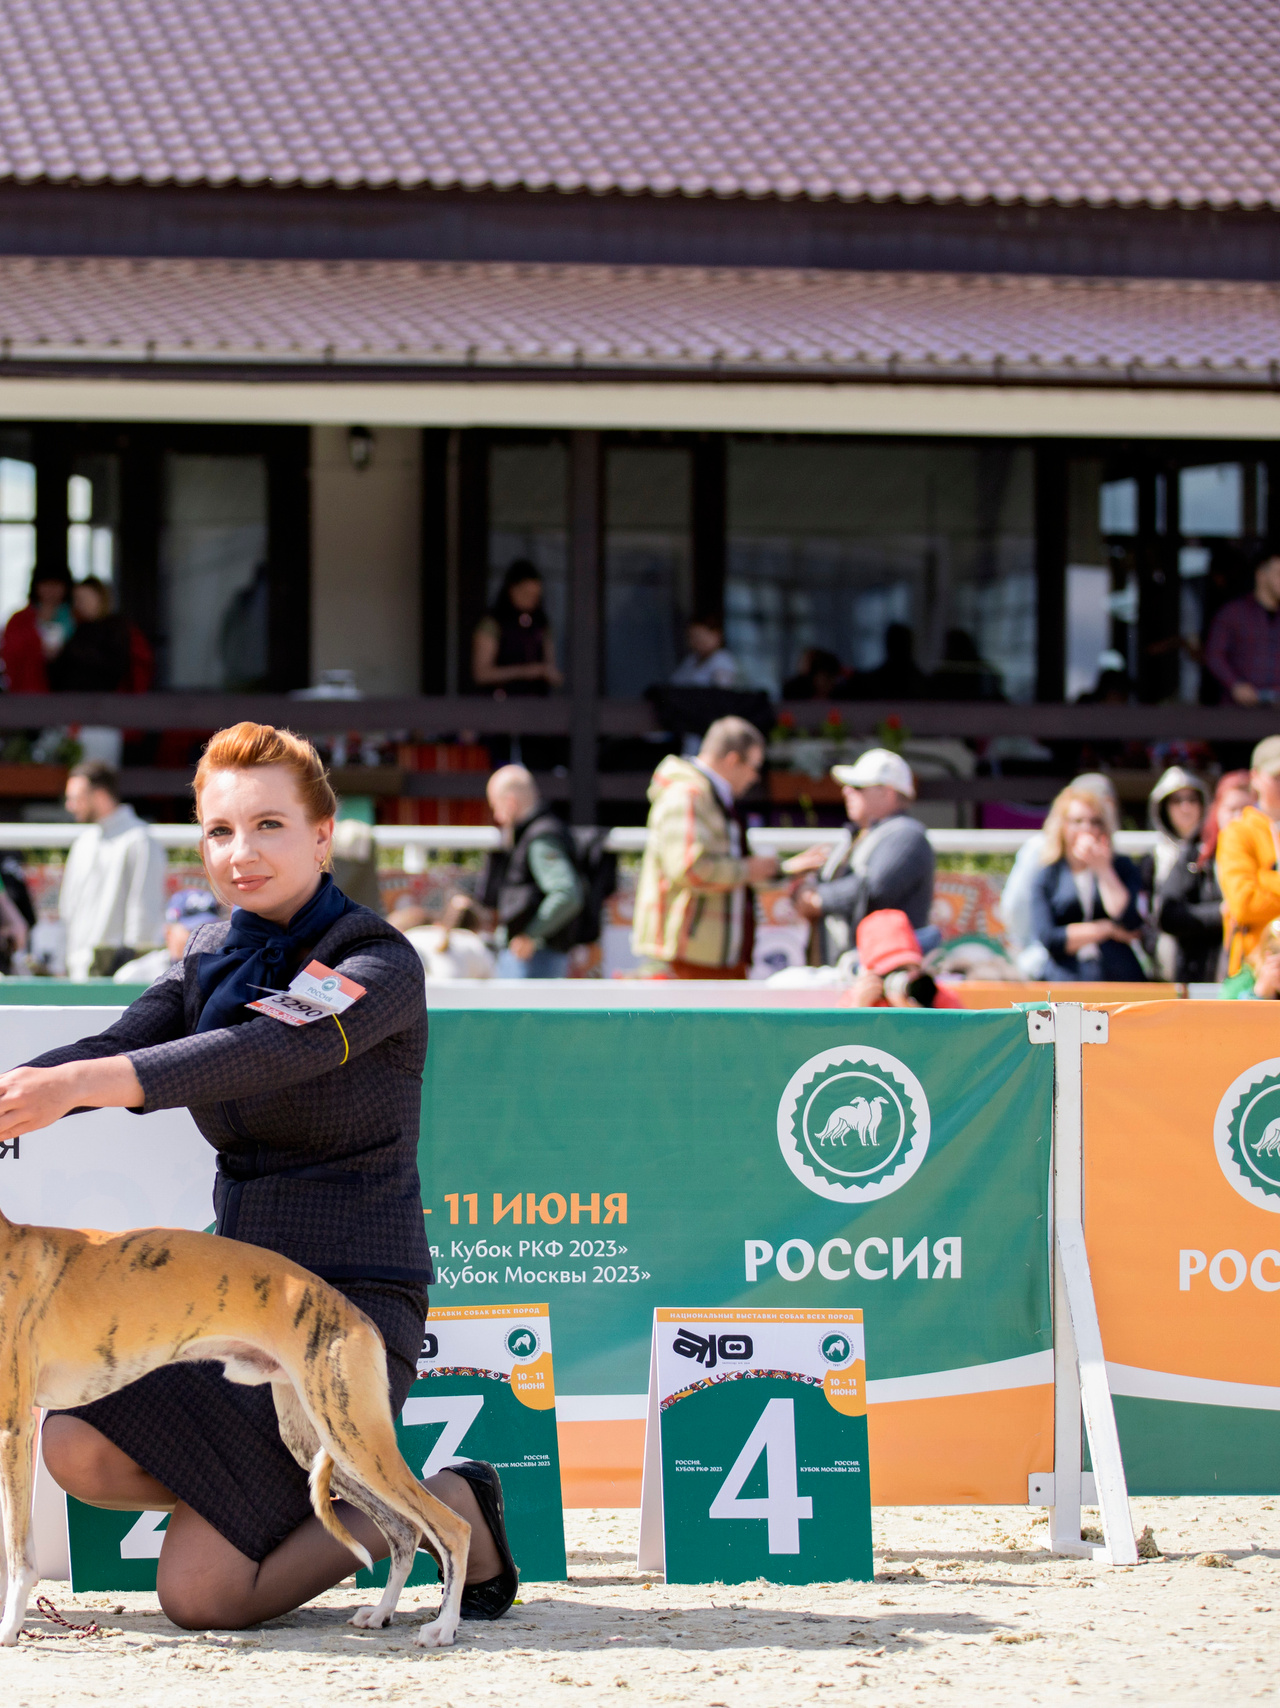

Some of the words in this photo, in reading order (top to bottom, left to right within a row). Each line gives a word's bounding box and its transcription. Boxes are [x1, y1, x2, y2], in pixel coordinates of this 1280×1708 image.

[272, 995, 323, 1017] 3290
[444, 1192, 478, 1224] 11
[493, 1192, 628, 1224] ИЮНЯ
[451, 1240, 512, 1262] Кубок
[519, 1240, 564, 1258] РКФ
[569, 1240, 628, 1258] 2023»
[745, 1236, 962, 1282] РОССИЯ
[437, 1266, 499, 1288] Кубок
[505, 1266, 586, 1284] Москвы
[592, 1266, 652, 1284] 2023»
[709, 1398, 813, 1554] 4
